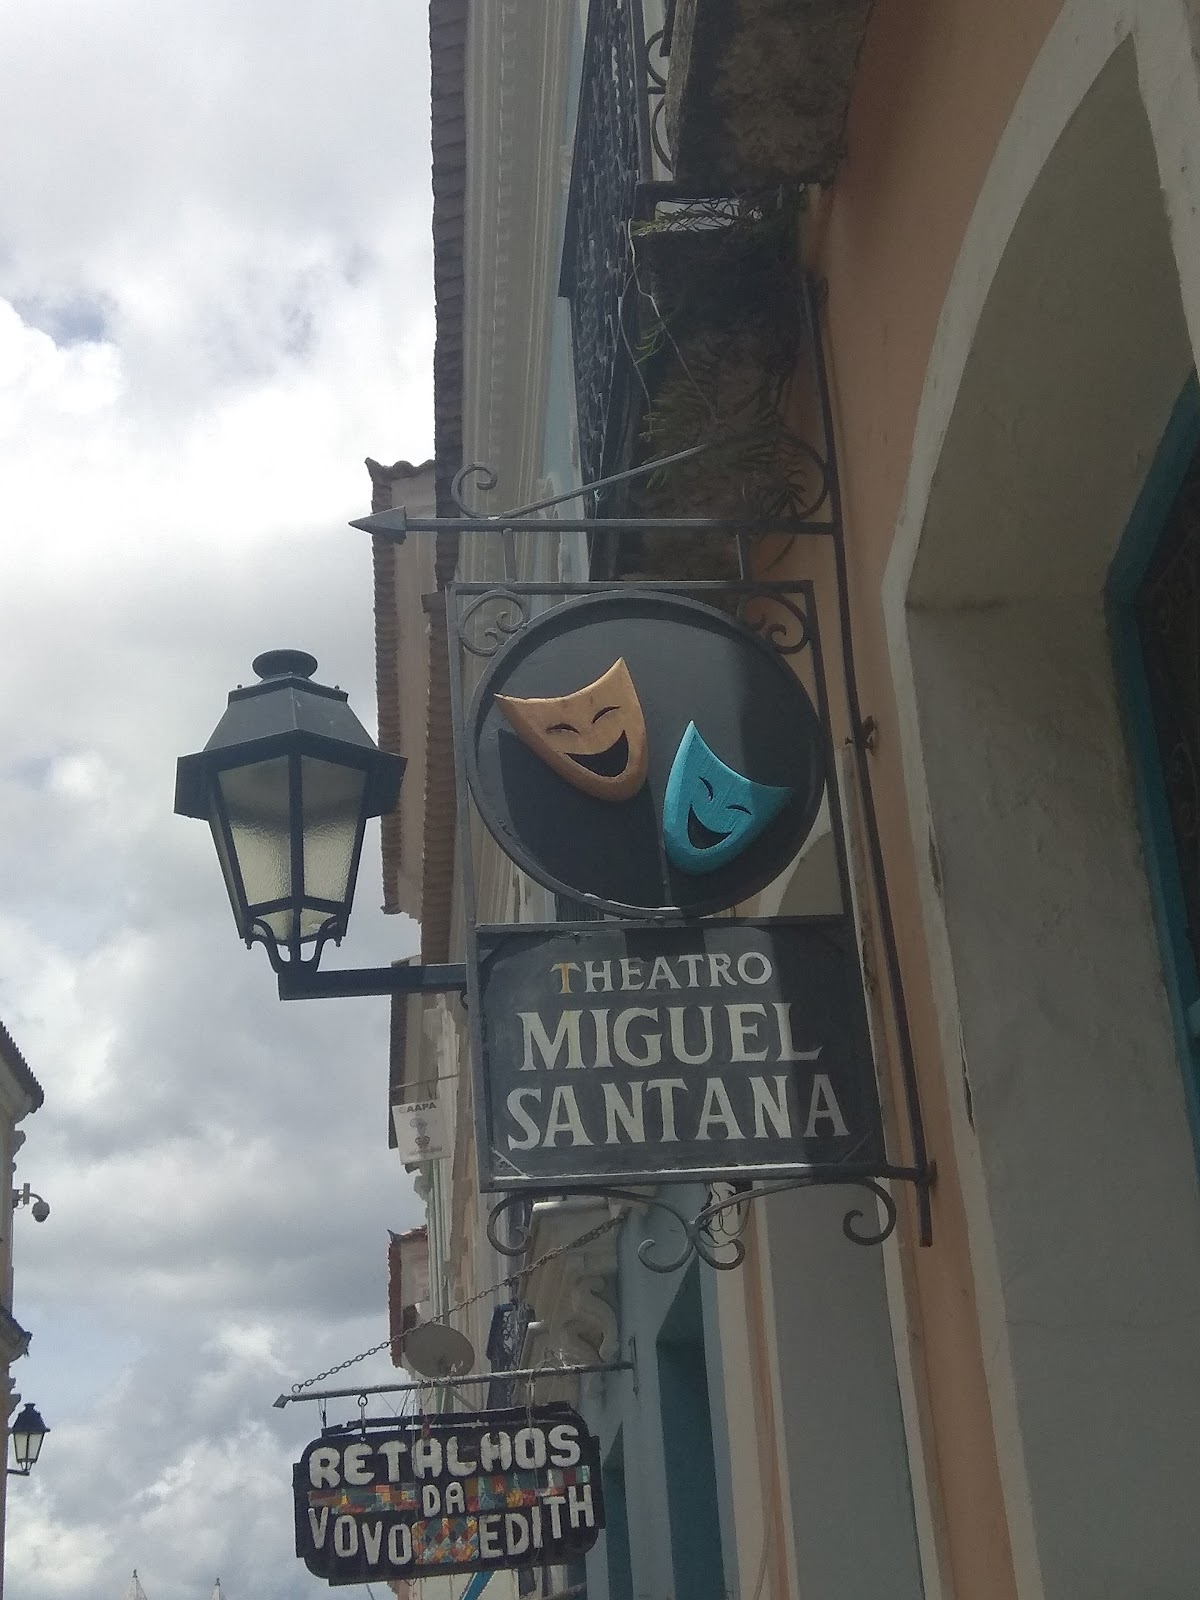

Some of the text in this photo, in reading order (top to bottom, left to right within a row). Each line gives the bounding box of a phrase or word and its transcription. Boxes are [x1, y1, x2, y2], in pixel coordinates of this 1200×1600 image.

[550, 951, 772, 994] THEATRO
[517, 1003, 822, 1071] MIGUEL
[507, 1074, 850, 1150] SANTANA
[308, 1424, 581, 1488] RETALHOS
[307, 1485, 595, 1565] VOVO EDITH
[422, 1481, 465, 1517] DA
